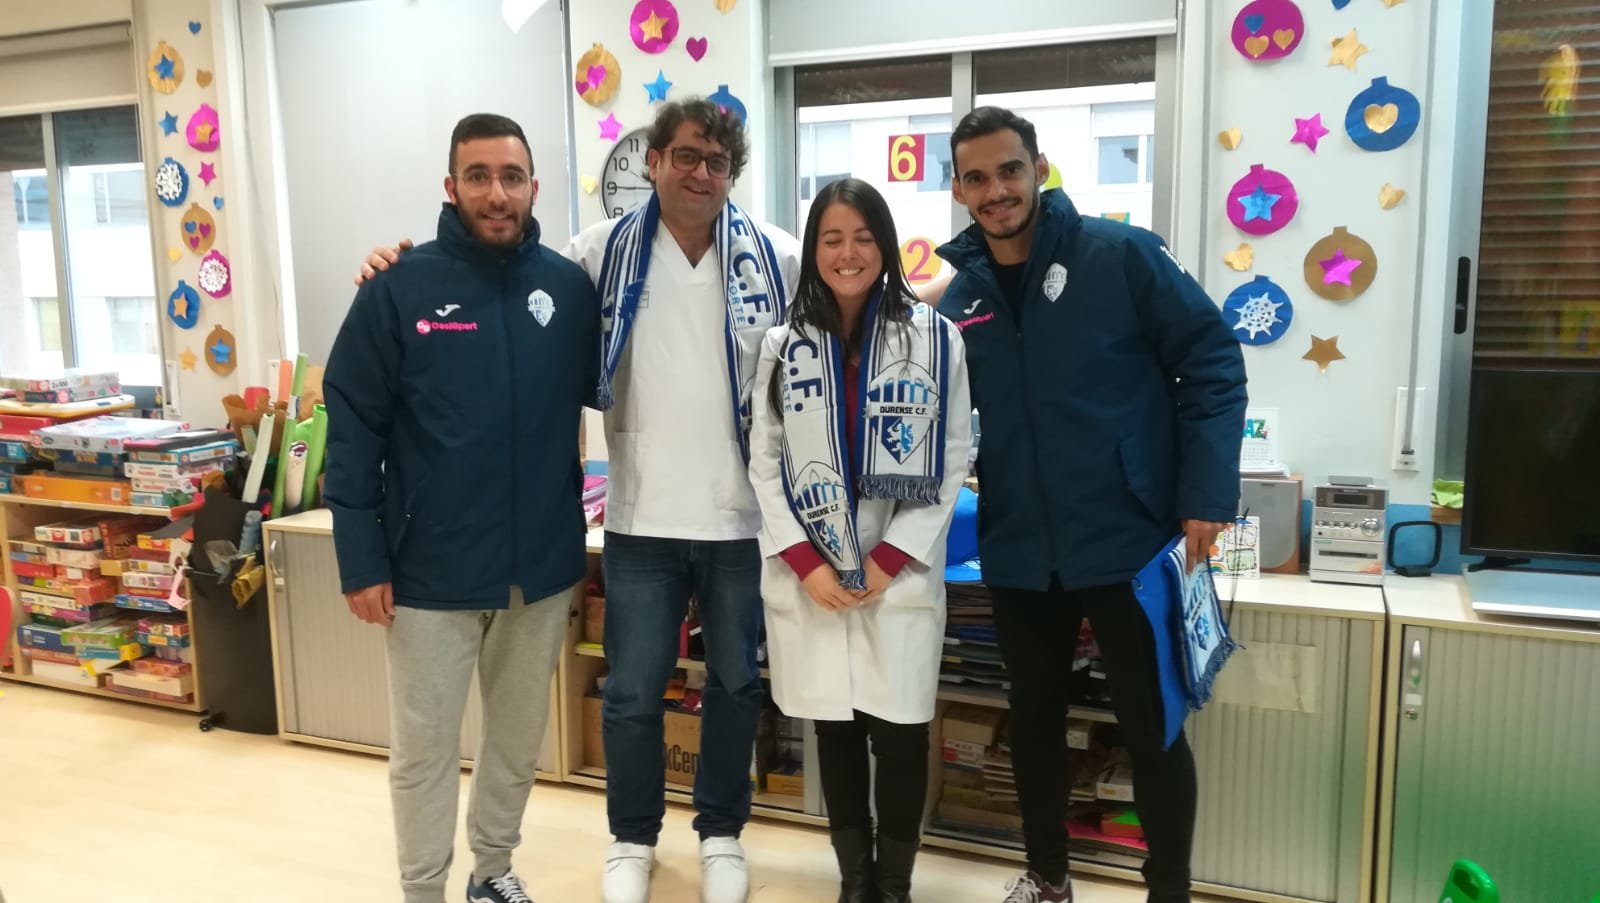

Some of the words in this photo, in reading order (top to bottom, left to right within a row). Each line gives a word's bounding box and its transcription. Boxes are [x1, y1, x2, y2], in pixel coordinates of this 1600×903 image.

[628, 138, 639, 153] 11
[890, 135, 917, 181] 6
[613, 156, 629, 172] 10
[606, 181, 618, 196] 9
[906, 239, 932, 281] 2
[733, 252, 771, 325] C.F.
[787, 338, 823, 412] C.F.
[879, 405, 914, 415] OURENSE
